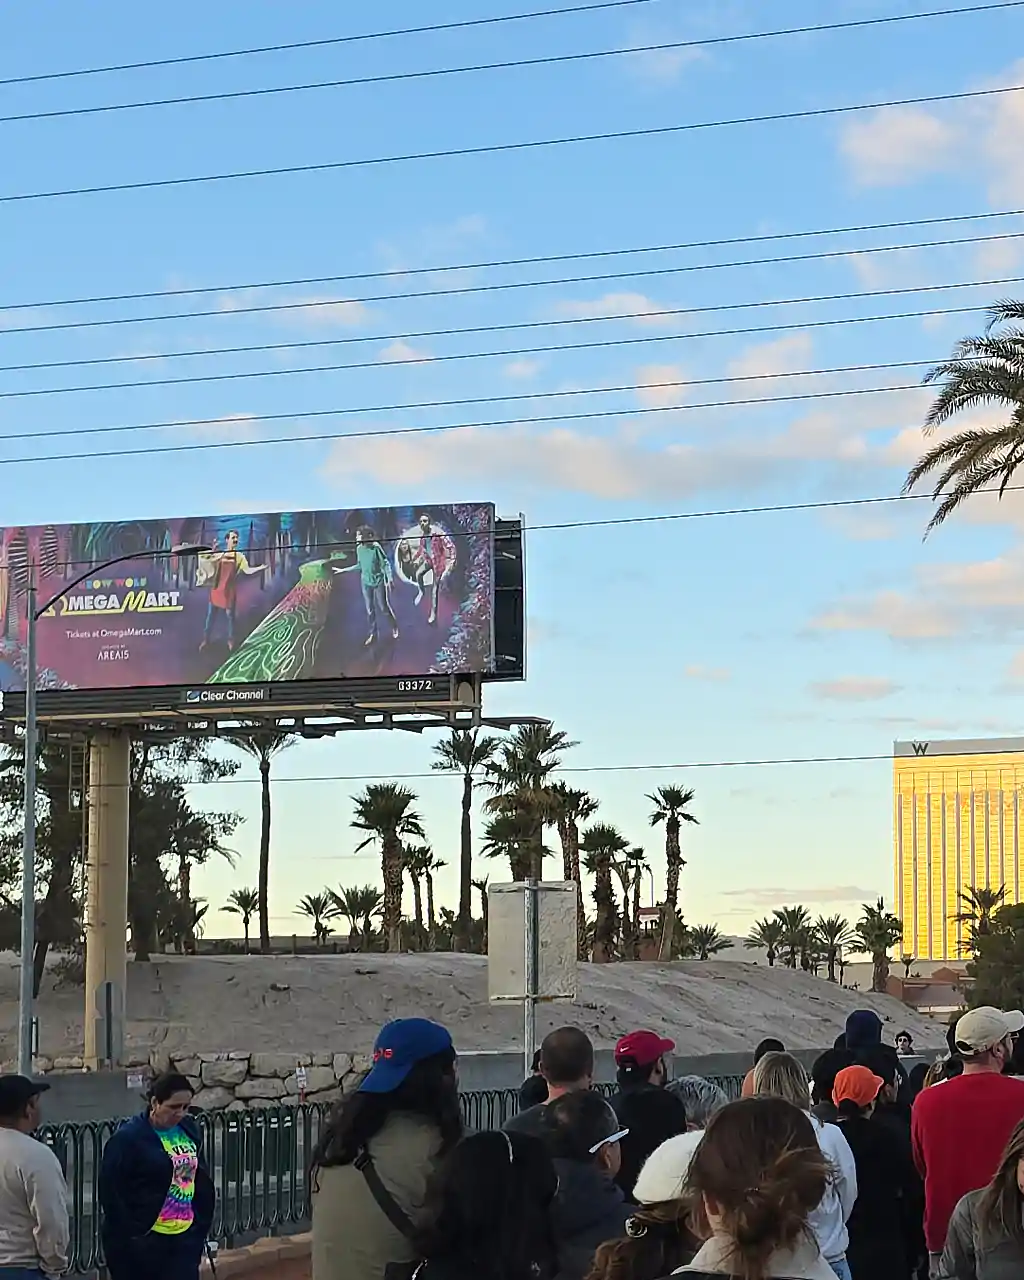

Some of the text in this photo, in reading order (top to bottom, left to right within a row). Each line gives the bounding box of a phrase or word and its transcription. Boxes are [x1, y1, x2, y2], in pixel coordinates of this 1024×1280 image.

[123, 590, 180, 612] MART
[65, 630, 91, 639] Tickets
[100, 628, 162, 639] OmegaMart.com
[201, 689, 264, 701] Clear Channel
